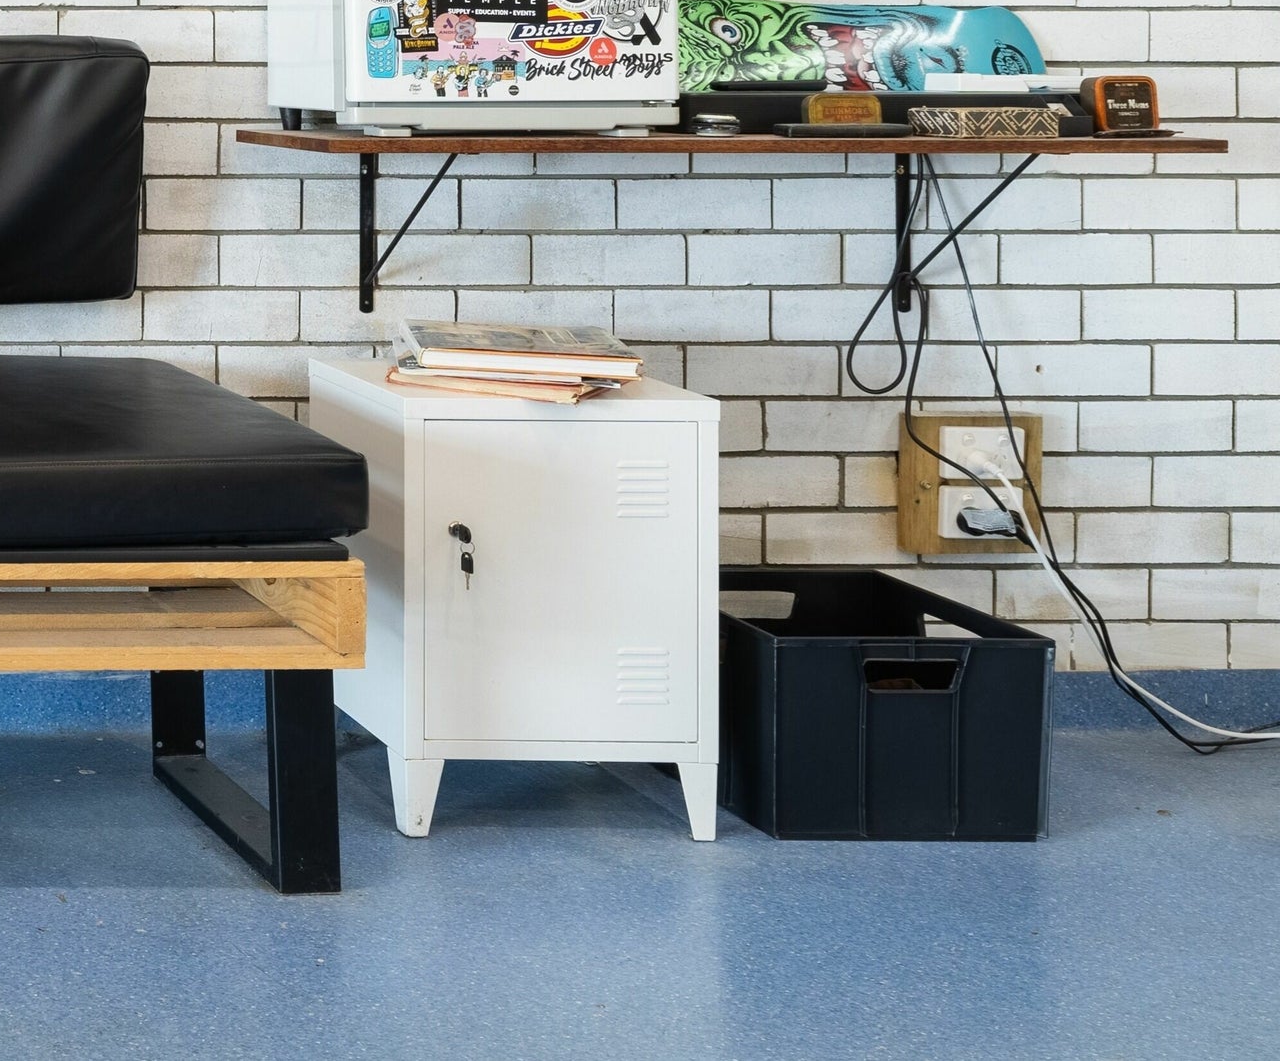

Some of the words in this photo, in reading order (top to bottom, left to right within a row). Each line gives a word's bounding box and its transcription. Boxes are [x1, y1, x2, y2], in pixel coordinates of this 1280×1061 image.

[513, 9, 536, 17] EVENTS
[518, 22, 594, 38] Dickies
[618, 53, 673, 64] ANDIS
[526, 58, 566, 81] Brick
[568, 56, 619, 81] Street
[624, 59, 665, 79] Boys
